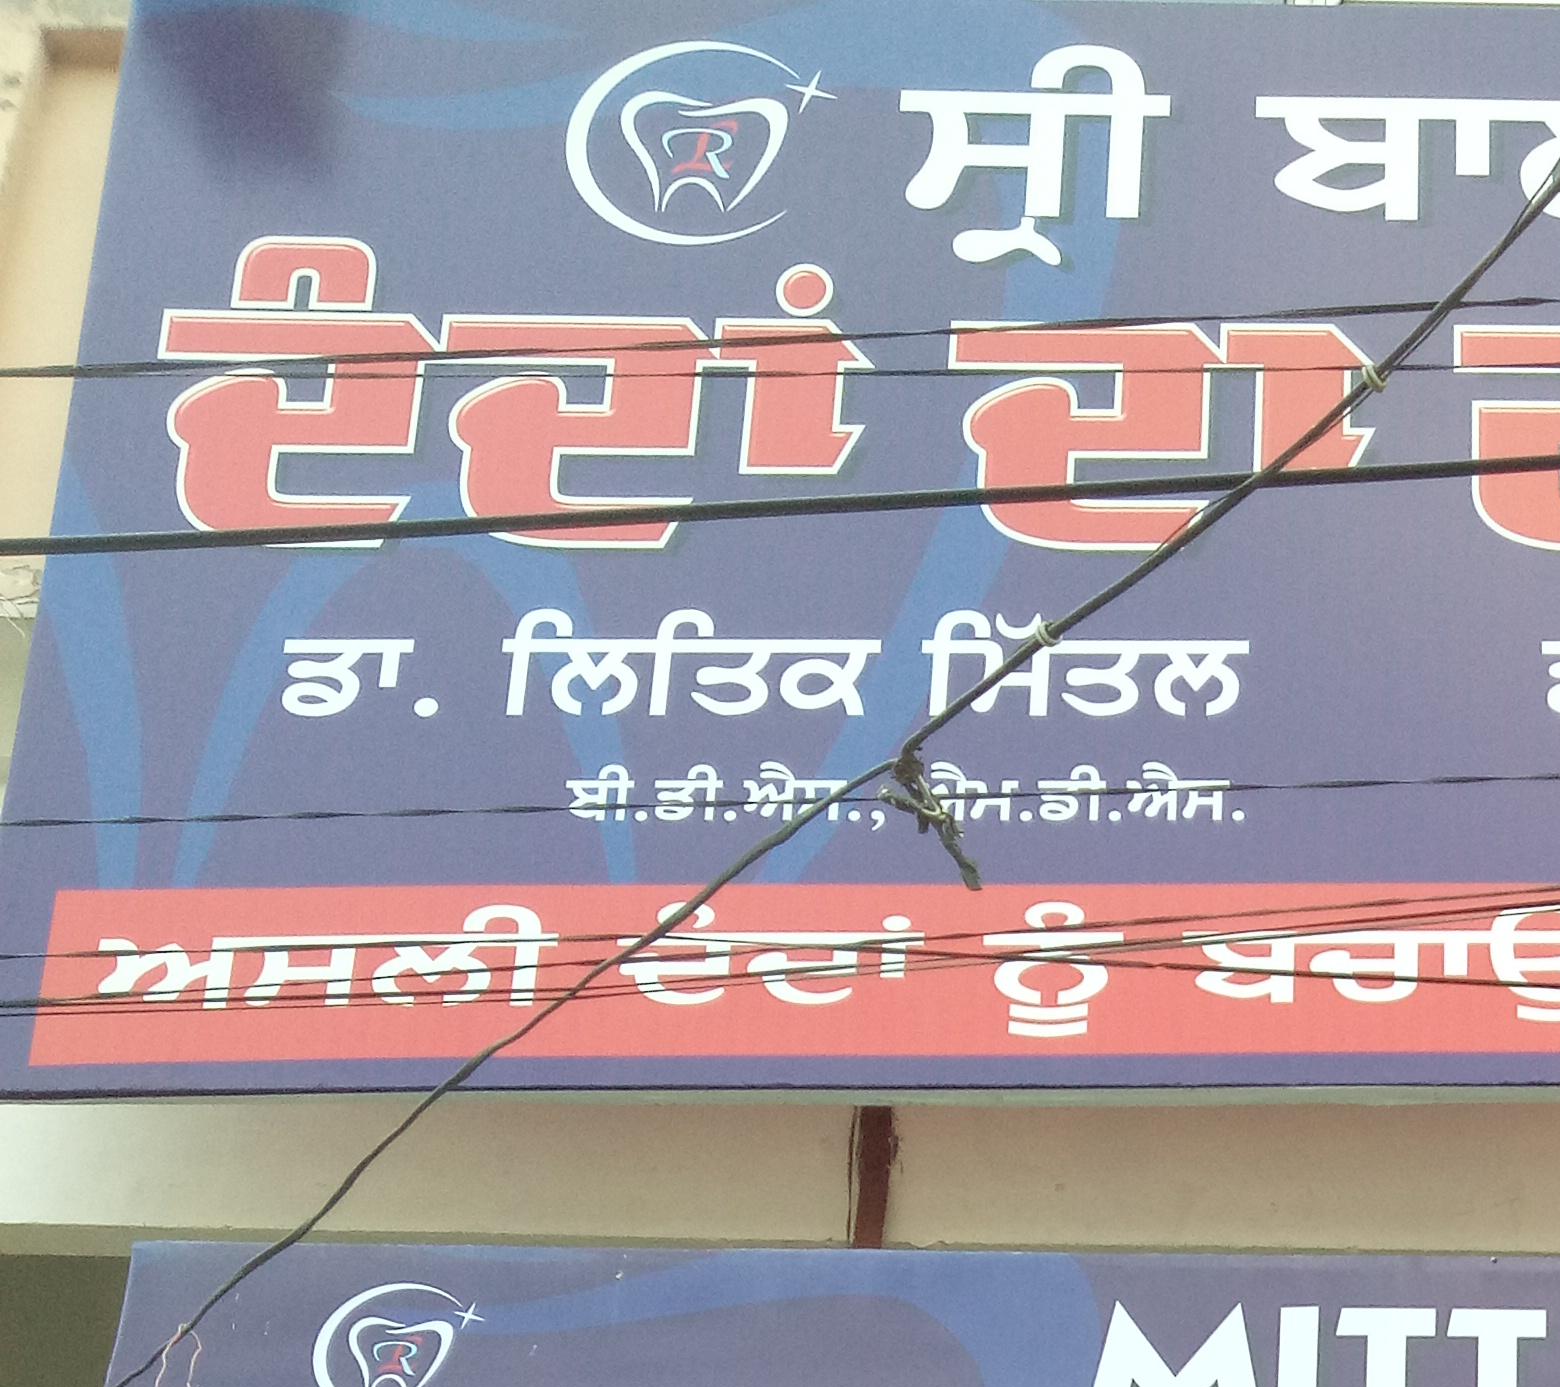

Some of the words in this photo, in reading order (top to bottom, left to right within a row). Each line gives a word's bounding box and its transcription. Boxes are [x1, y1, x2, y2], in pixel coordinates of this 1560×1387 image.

[900, 43, 1171, 265] ਸ੍ਰੀ
[158, 235, 875, 548] ਦੰਦਾਂ
[948, 322, 1376, 551] ਦਾ
[282, 639, 438, 717] ਡਾ.
[502, 609, 881, 715] ਲਿਤਿਕ
[922, 610, 1249, 716] ਮਿੱਤਲ
[97, 904, 558, 1009] ਅਸਲੀ
[617, 903, 923, 1005] ਦੰਦਾਂ
[983, 901, 1123, 1037] ਨੂੰ
